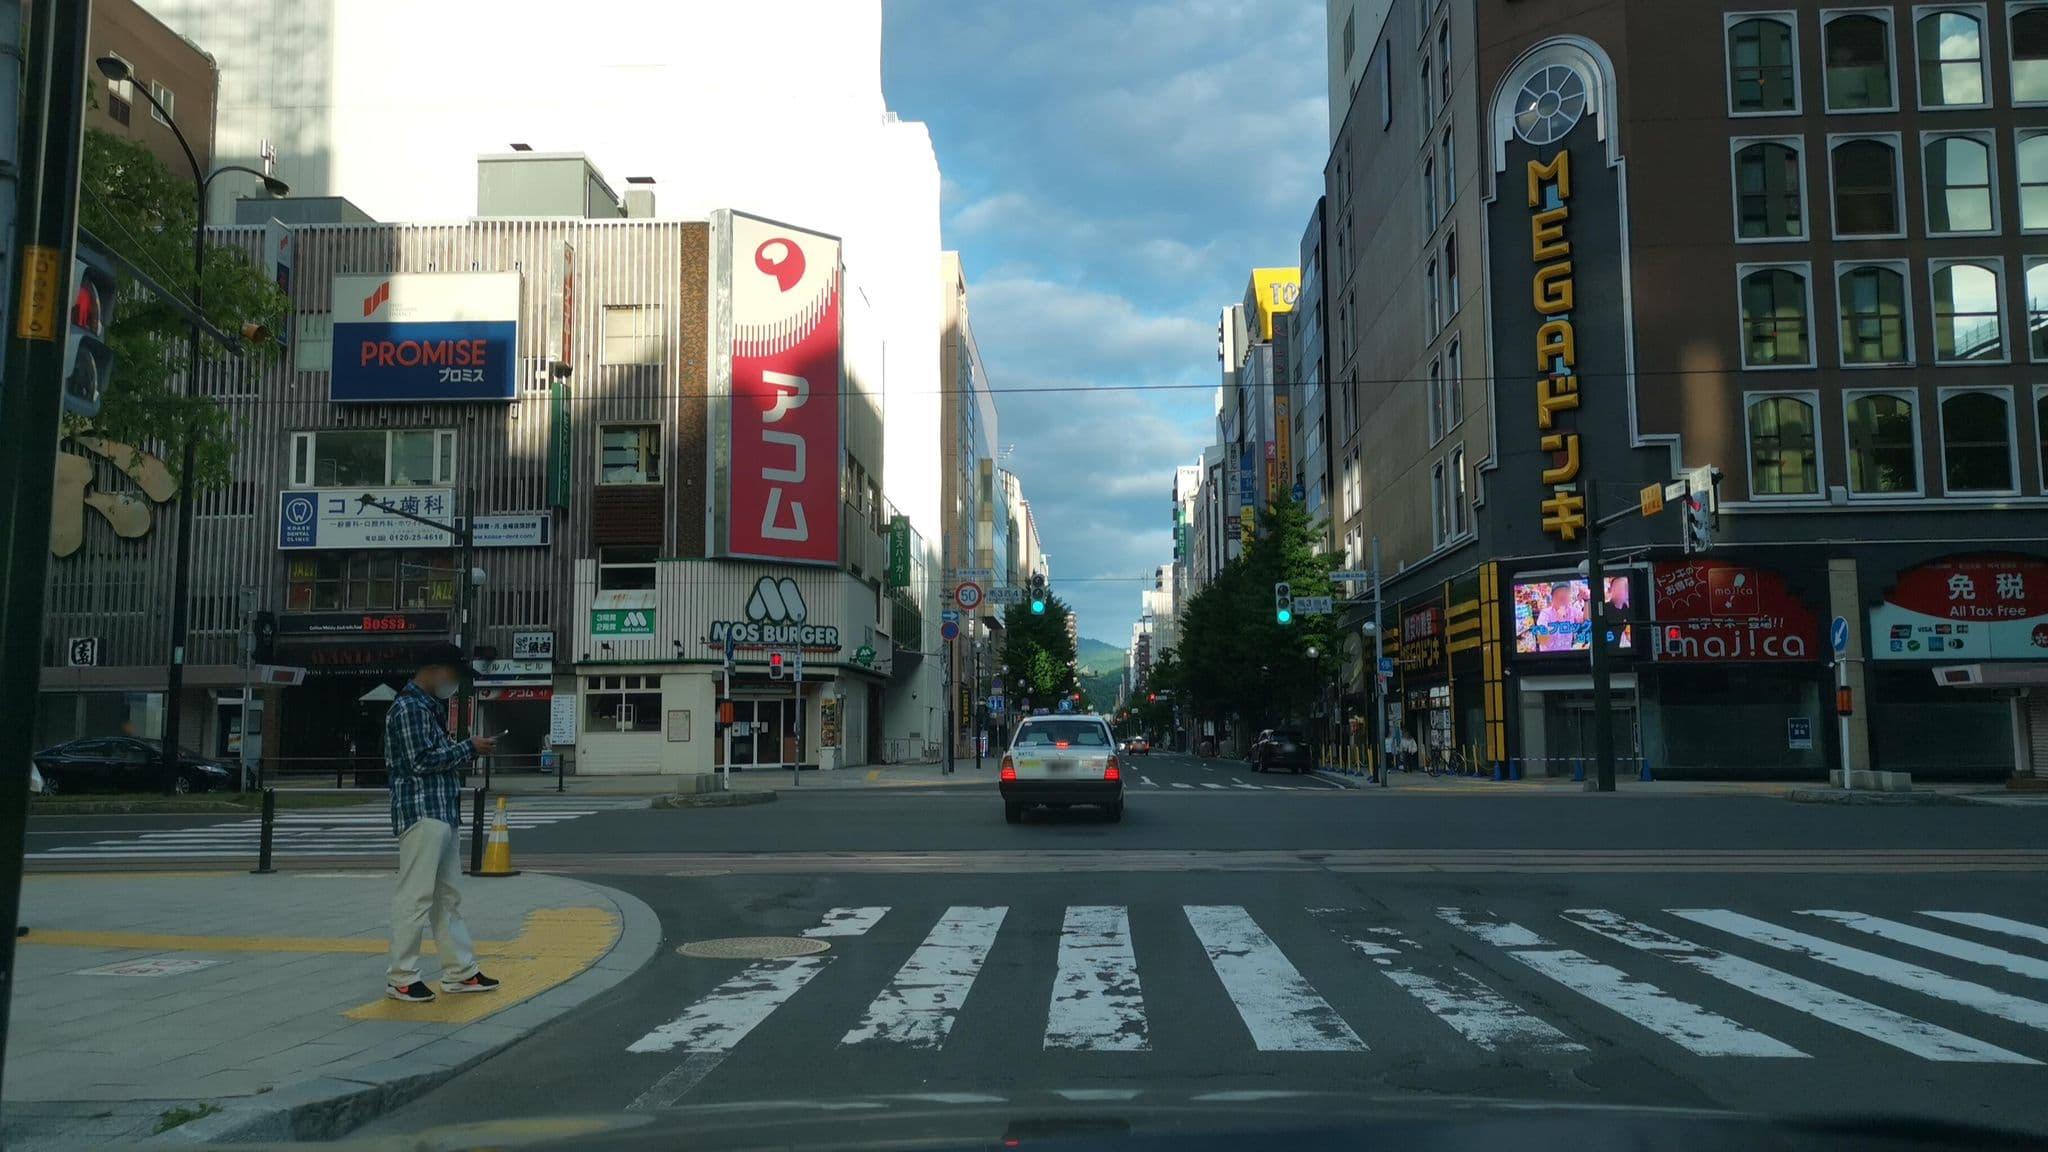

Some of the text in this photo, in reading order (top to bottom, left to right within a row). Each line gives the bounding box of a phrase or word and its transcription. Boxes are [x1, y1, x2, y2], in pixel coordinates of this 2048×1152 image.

[361, 339, 489, 367] PROMISE
[1527, 149, 1586, 541] MEGAドンキ
[438, 368, 485, 383] プロミス
[761, 369, 810, 541] アコム
[894, 530, 905, 581] モスバーガー
[960, 588, 977, 602] 50
[1947, 572, 2026, 600] 免税
[1950, 604, 2027, 617] All Tax Free
[362, 616, 406, 631] Bossa
[711, 621, 839, 646] MOS BURGER
[508, 689, 534, 698] アコム
